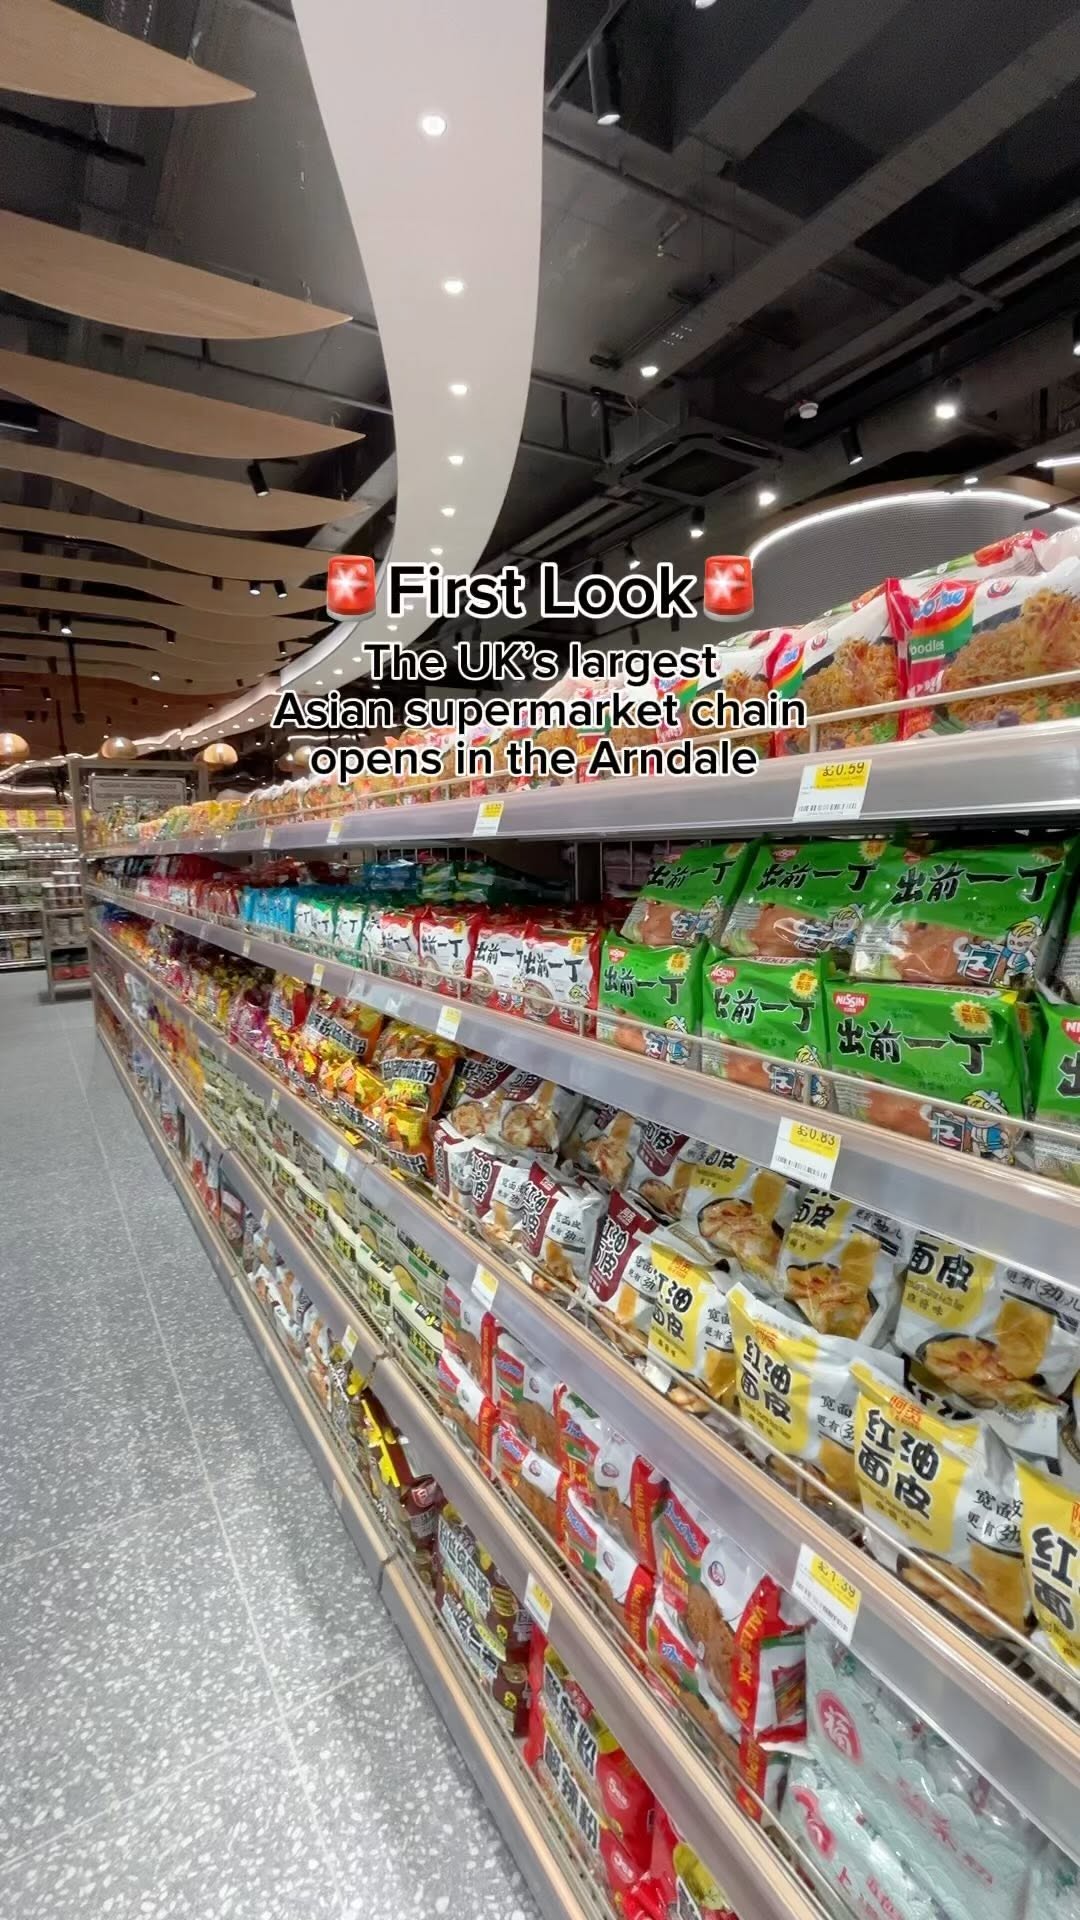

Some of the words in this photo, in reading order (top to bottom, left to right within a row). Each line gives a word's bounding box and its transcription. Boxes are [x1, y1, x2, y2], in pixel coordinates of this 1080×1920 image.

[910, 640, 945, 656] oodles
[822, 762, 865, 777] £0.59
[648, 861, 736, 889] 出前一丁
[756, 863, 880, 892] 出前一丁
[890, 861, 1064, 903] 出前一丁
[523, 950, 584, 983] 出前一丁
[604, 965, 686, 1006] 出前一丁
[713, 987, 815, 1033] 出前一丁
[835, 993, 865, 1008] NISSIN
[836, 1017, 993, 1076] 出前一丁
[796, 1124, 836, 1146] £0.83
[908, 1239, 975, 1293] 面皮
[743, 1335, 792, 1396] 红油
[740, 1365, 792, 1425] 面皮
[865, 1410, 939, 1481] 红油
[858, 1440, 932, 1520] 面皮
[816, 1559, 857, 1599] £1.39
